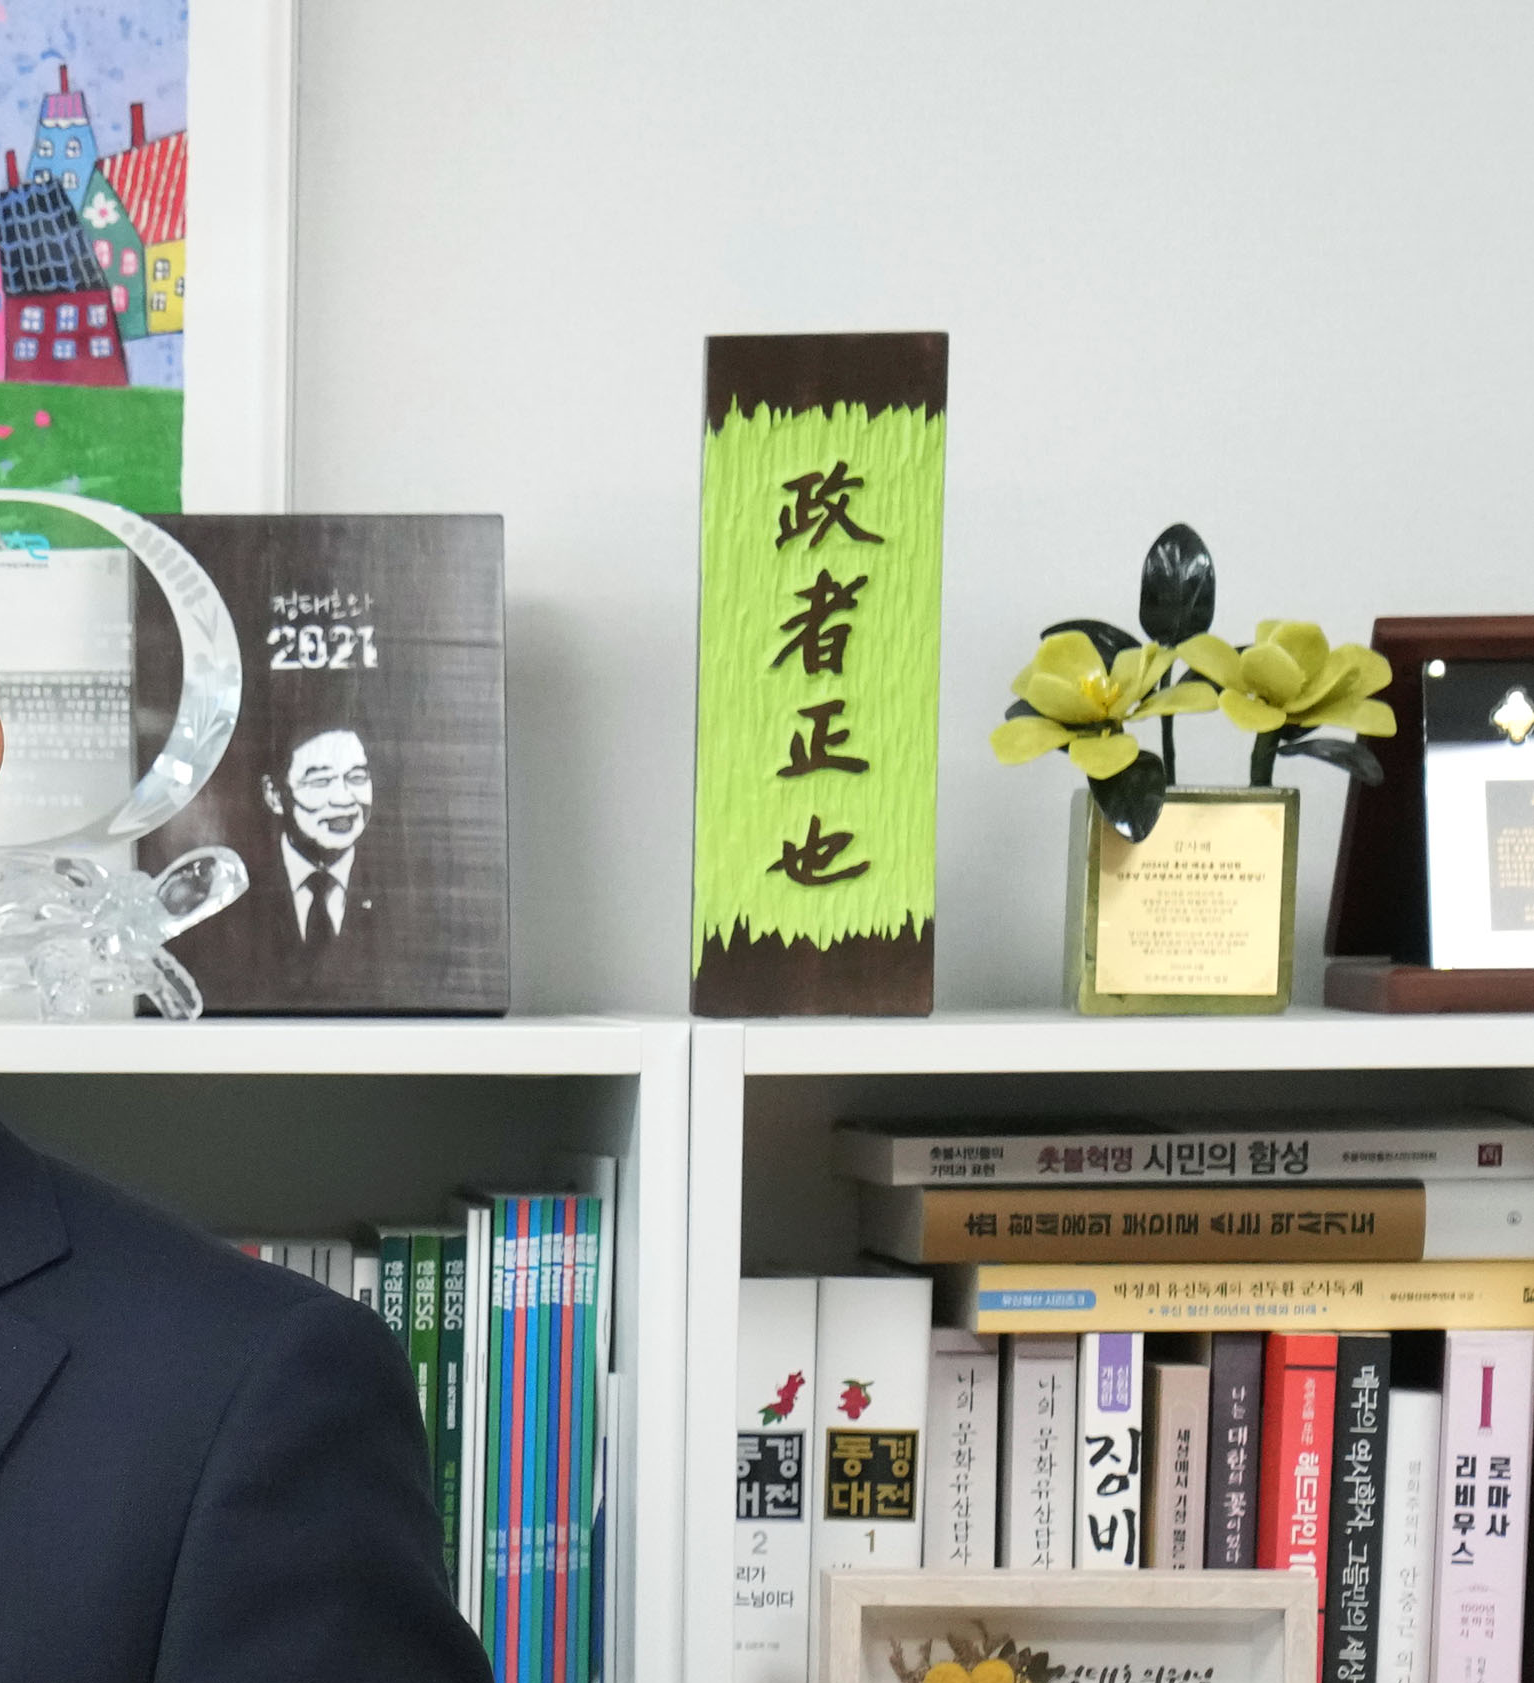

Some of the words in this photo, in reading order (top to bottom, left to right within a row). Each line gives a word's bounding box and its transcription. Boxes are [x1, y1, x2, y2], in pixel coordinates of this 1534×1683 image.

[266, 624, 379, 671] 2021
[766, 461, 885, 887] 政者正也
[1037, 1146, 1134, 1174] 촛불혁명
[1142, 1141, 1236, 1176] 시민의
[1247, 1140, 1309, 1176] 함성
[384, 1259, 404, 1331] 한경ESG
[416, 1259, 436, 1331] 한경ESG
[444, 1259, 464, 1331] 한경ESG
[1113, 1281, 1161, 1299] 박정희
[1249, 1280, 1295, 1297] 전두환
[1300, 1279, 1364, 1297] 군사독재
[953, 1368, 978, 1413] 나의
[1036, 1374, 1062, 1418] 나의
[1230, 1386, 1248, 1421] 나는
[1349, 1364, 1381, 1434] 매국의
[831, 1435, 915, 1476] 동경
[1227, 1427, 1249, 1489] 대한의
[1344, 1439, 1376, 1536] 역사학자,
[831, 1481, 914, 1517] 대전
[949, 1421, 978, 1566] 문화유산답사
[1031, 1429, 1057, 1570] 문화유산답사
[1084, 1427, 1142, 1565] 징비
[1291, 1452, 1322, 1546] 헤드라인
[1451, 1453, 1477, 1566] 리비우스
[1485, 1455, 1513, 1537] 로마사
[751, 1530, 769, 1556] 2
[863, 1529, 877, 1554] 1
[1340, 1541, 1369, 1633] 그들만의
[1398, 1567, 1420, 1641] 안중근
[1337, 1636, 1367, 1683] 세상
